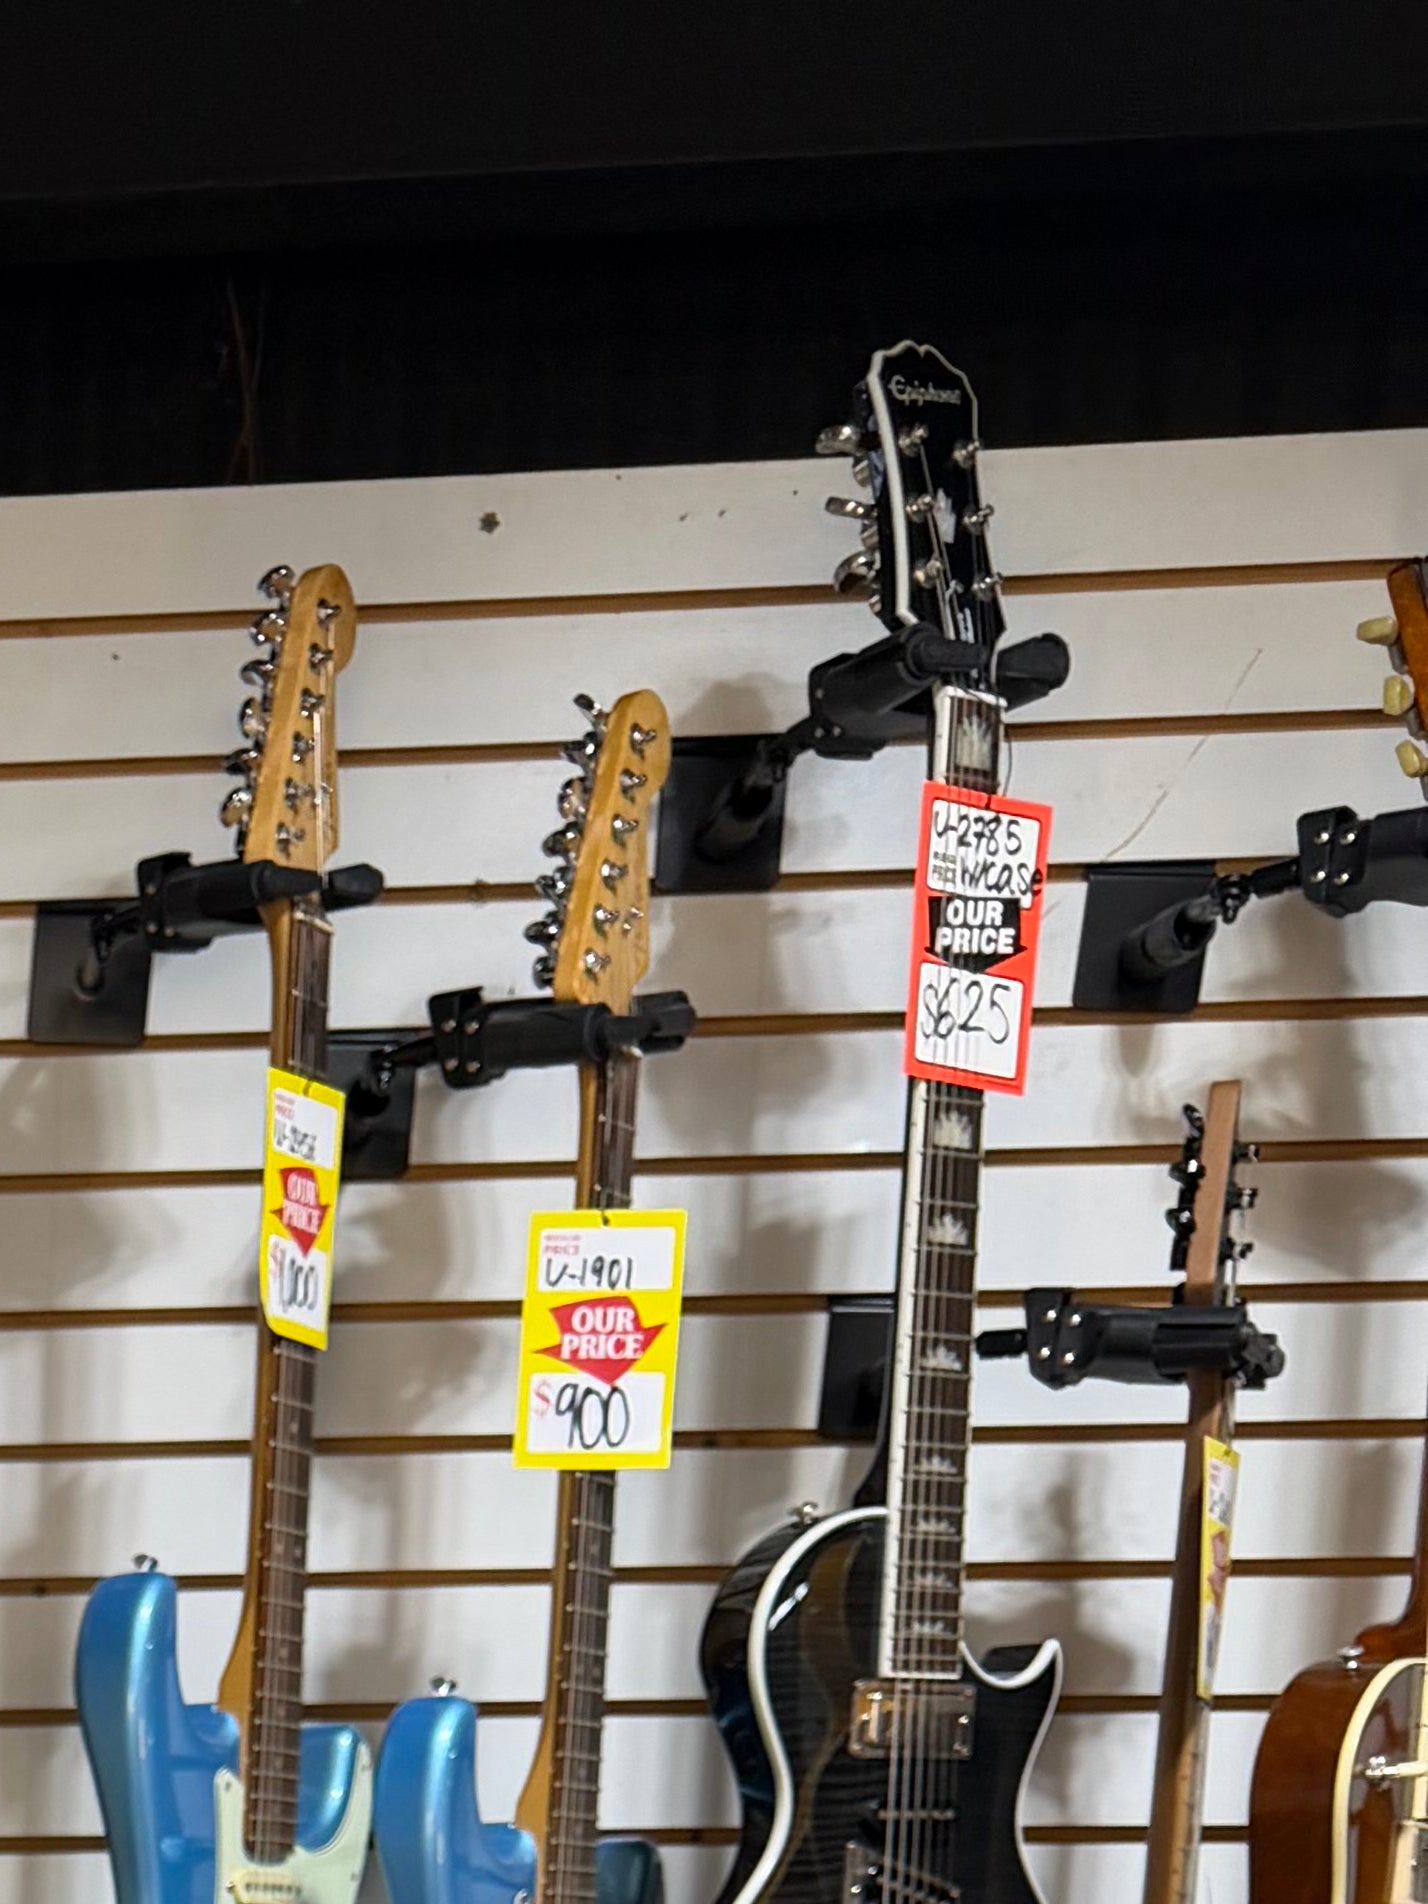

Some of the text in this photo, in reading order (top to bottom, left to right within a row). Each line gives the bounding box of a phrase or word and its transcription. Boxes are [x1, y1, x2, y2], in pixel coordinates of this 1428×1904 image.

[946, 900, 1004, 927] OUR
[935, 926, 1016, 954] PRICE
[921, 977, 1011, 1044] $625
[286, 1170, 318, 1207] OUR
[281, 1200, 322, 1235] PRICE
[571, 1305, 635, 1333] OUR
[560, 1333, 645, 1361] PRICE
[533, 1379, 630, 1450] $900
